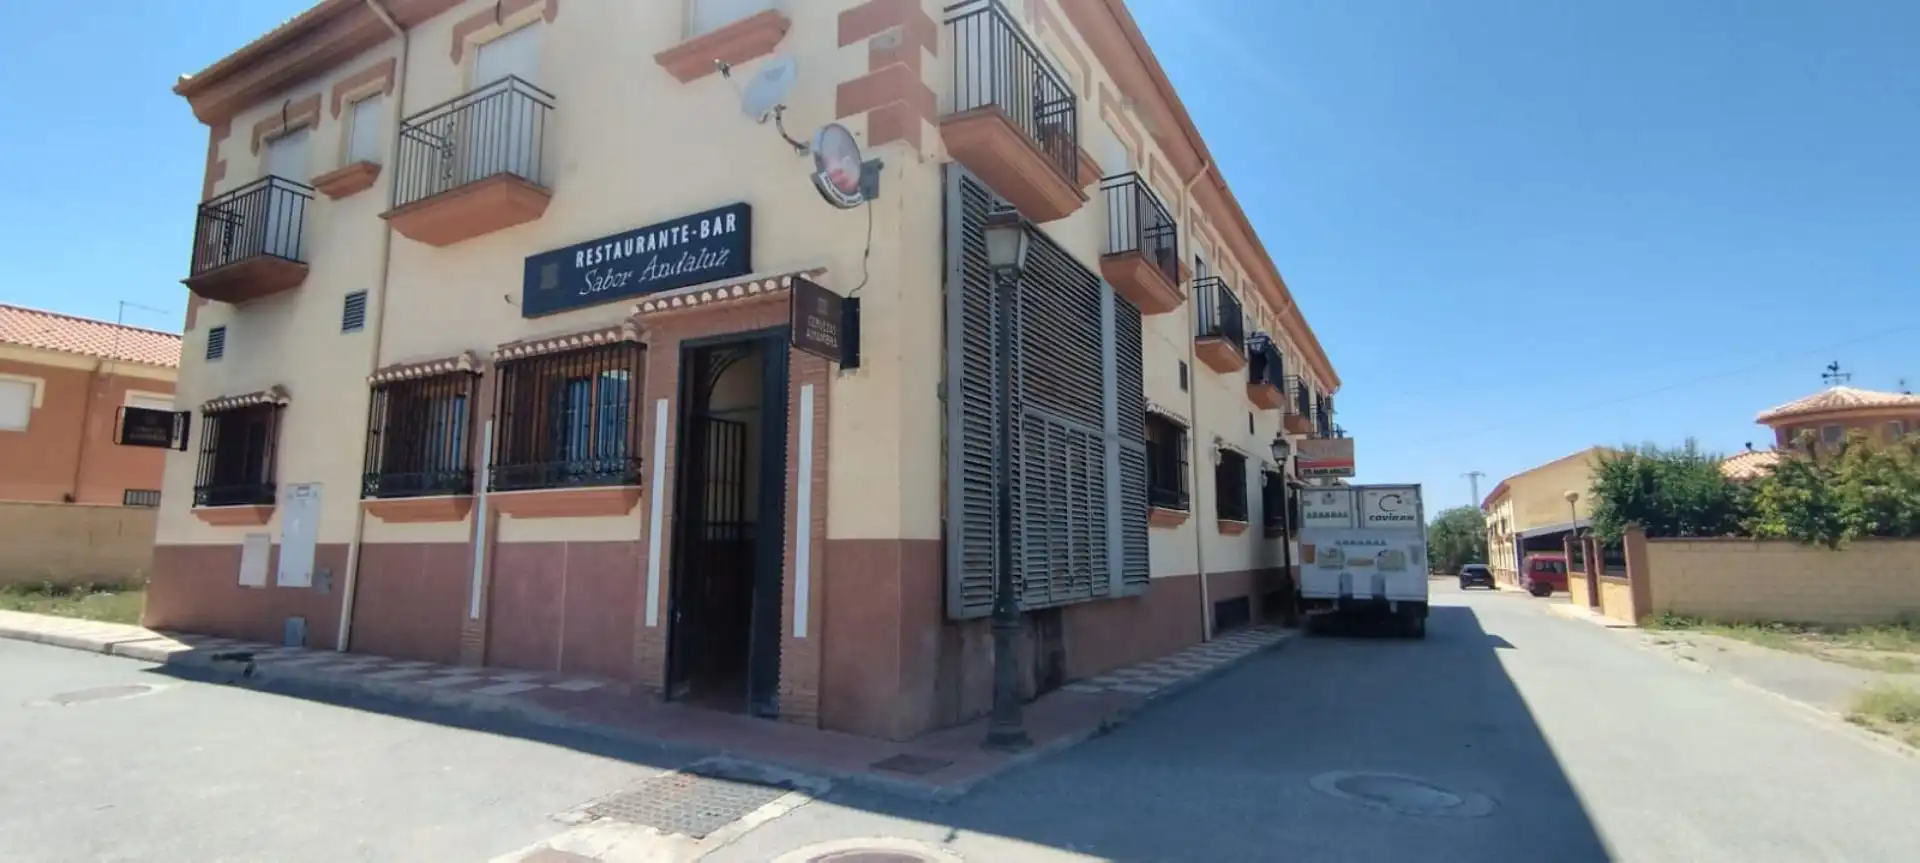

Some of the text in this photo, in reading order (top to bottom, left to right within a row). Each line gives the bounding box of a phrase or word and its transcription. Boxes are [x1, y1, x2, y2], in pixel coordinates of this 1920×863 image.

[575, 212, 737, 268] RESTAURANTE-BAR
[579, 246, 731, 296] Sabor Andaluz
